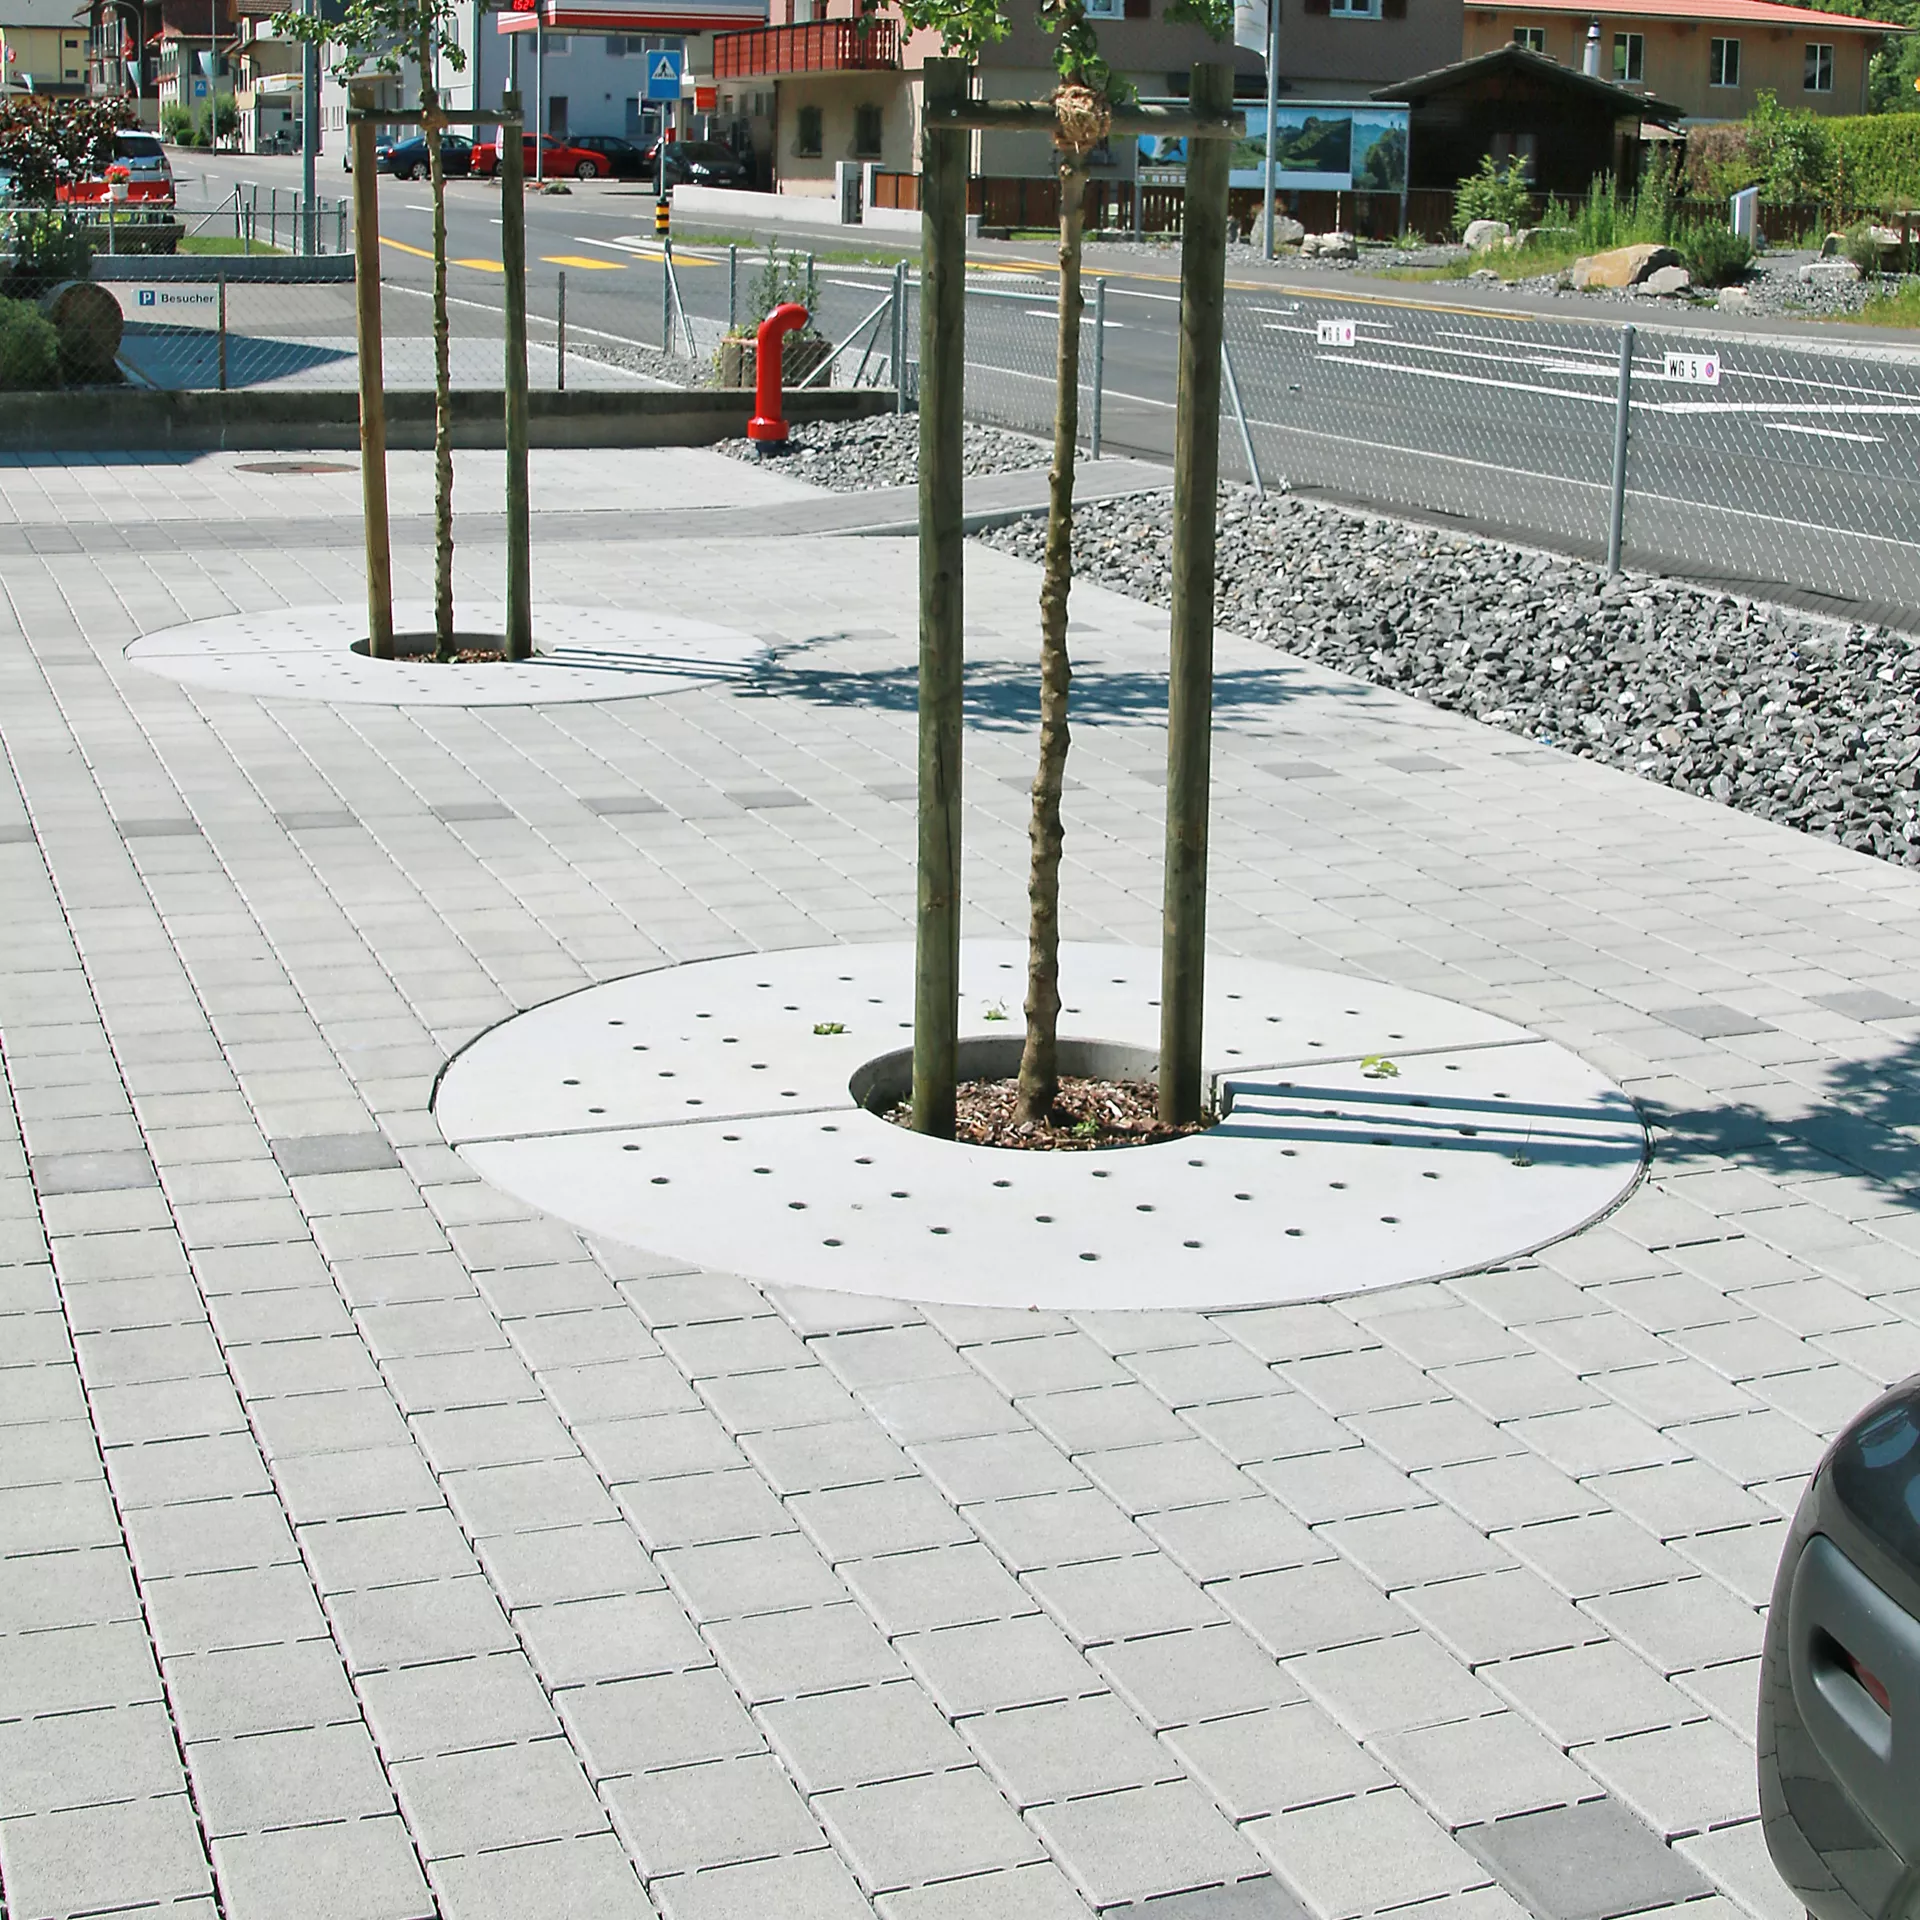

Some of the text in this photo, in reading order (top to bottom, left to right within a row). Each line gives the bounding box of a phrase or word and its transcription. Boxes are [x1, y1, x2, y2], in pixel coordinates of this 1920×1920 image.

[161, 294, 214, 303] Besucher
[1669, 360, 1698, 379] WG 5
